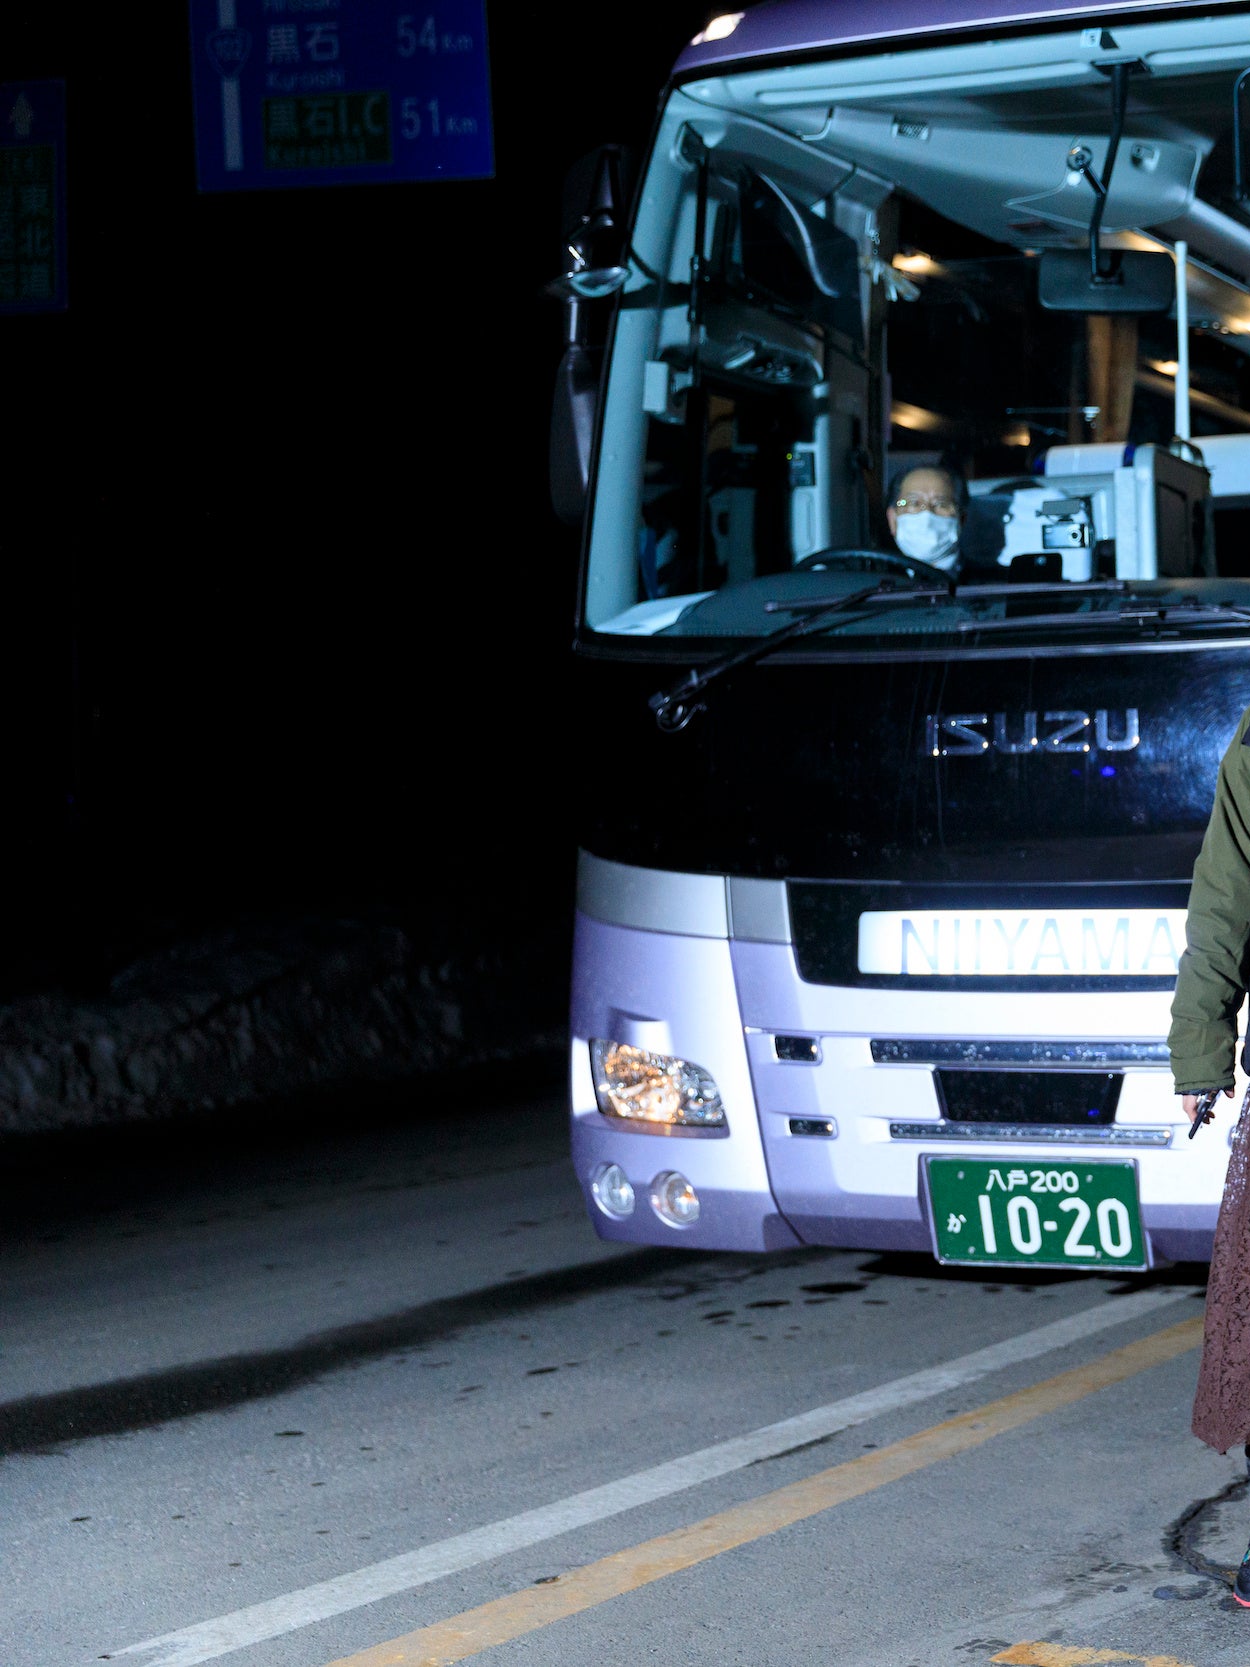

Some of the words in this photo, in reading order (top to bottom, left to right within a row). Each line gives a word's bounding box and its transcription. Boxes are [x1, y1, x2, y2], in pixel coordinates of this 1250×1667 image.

[267, 22, 339, 62] 黒石
[267, 68, 344, 90] Kuroishi
[926, 708, 1139, 756] ISUZU
[900, 917, 1181, 974] NIIYAMA
[947, 1213, 967, 1233] か
[978, 1194, 1133, 1258] 10-20
